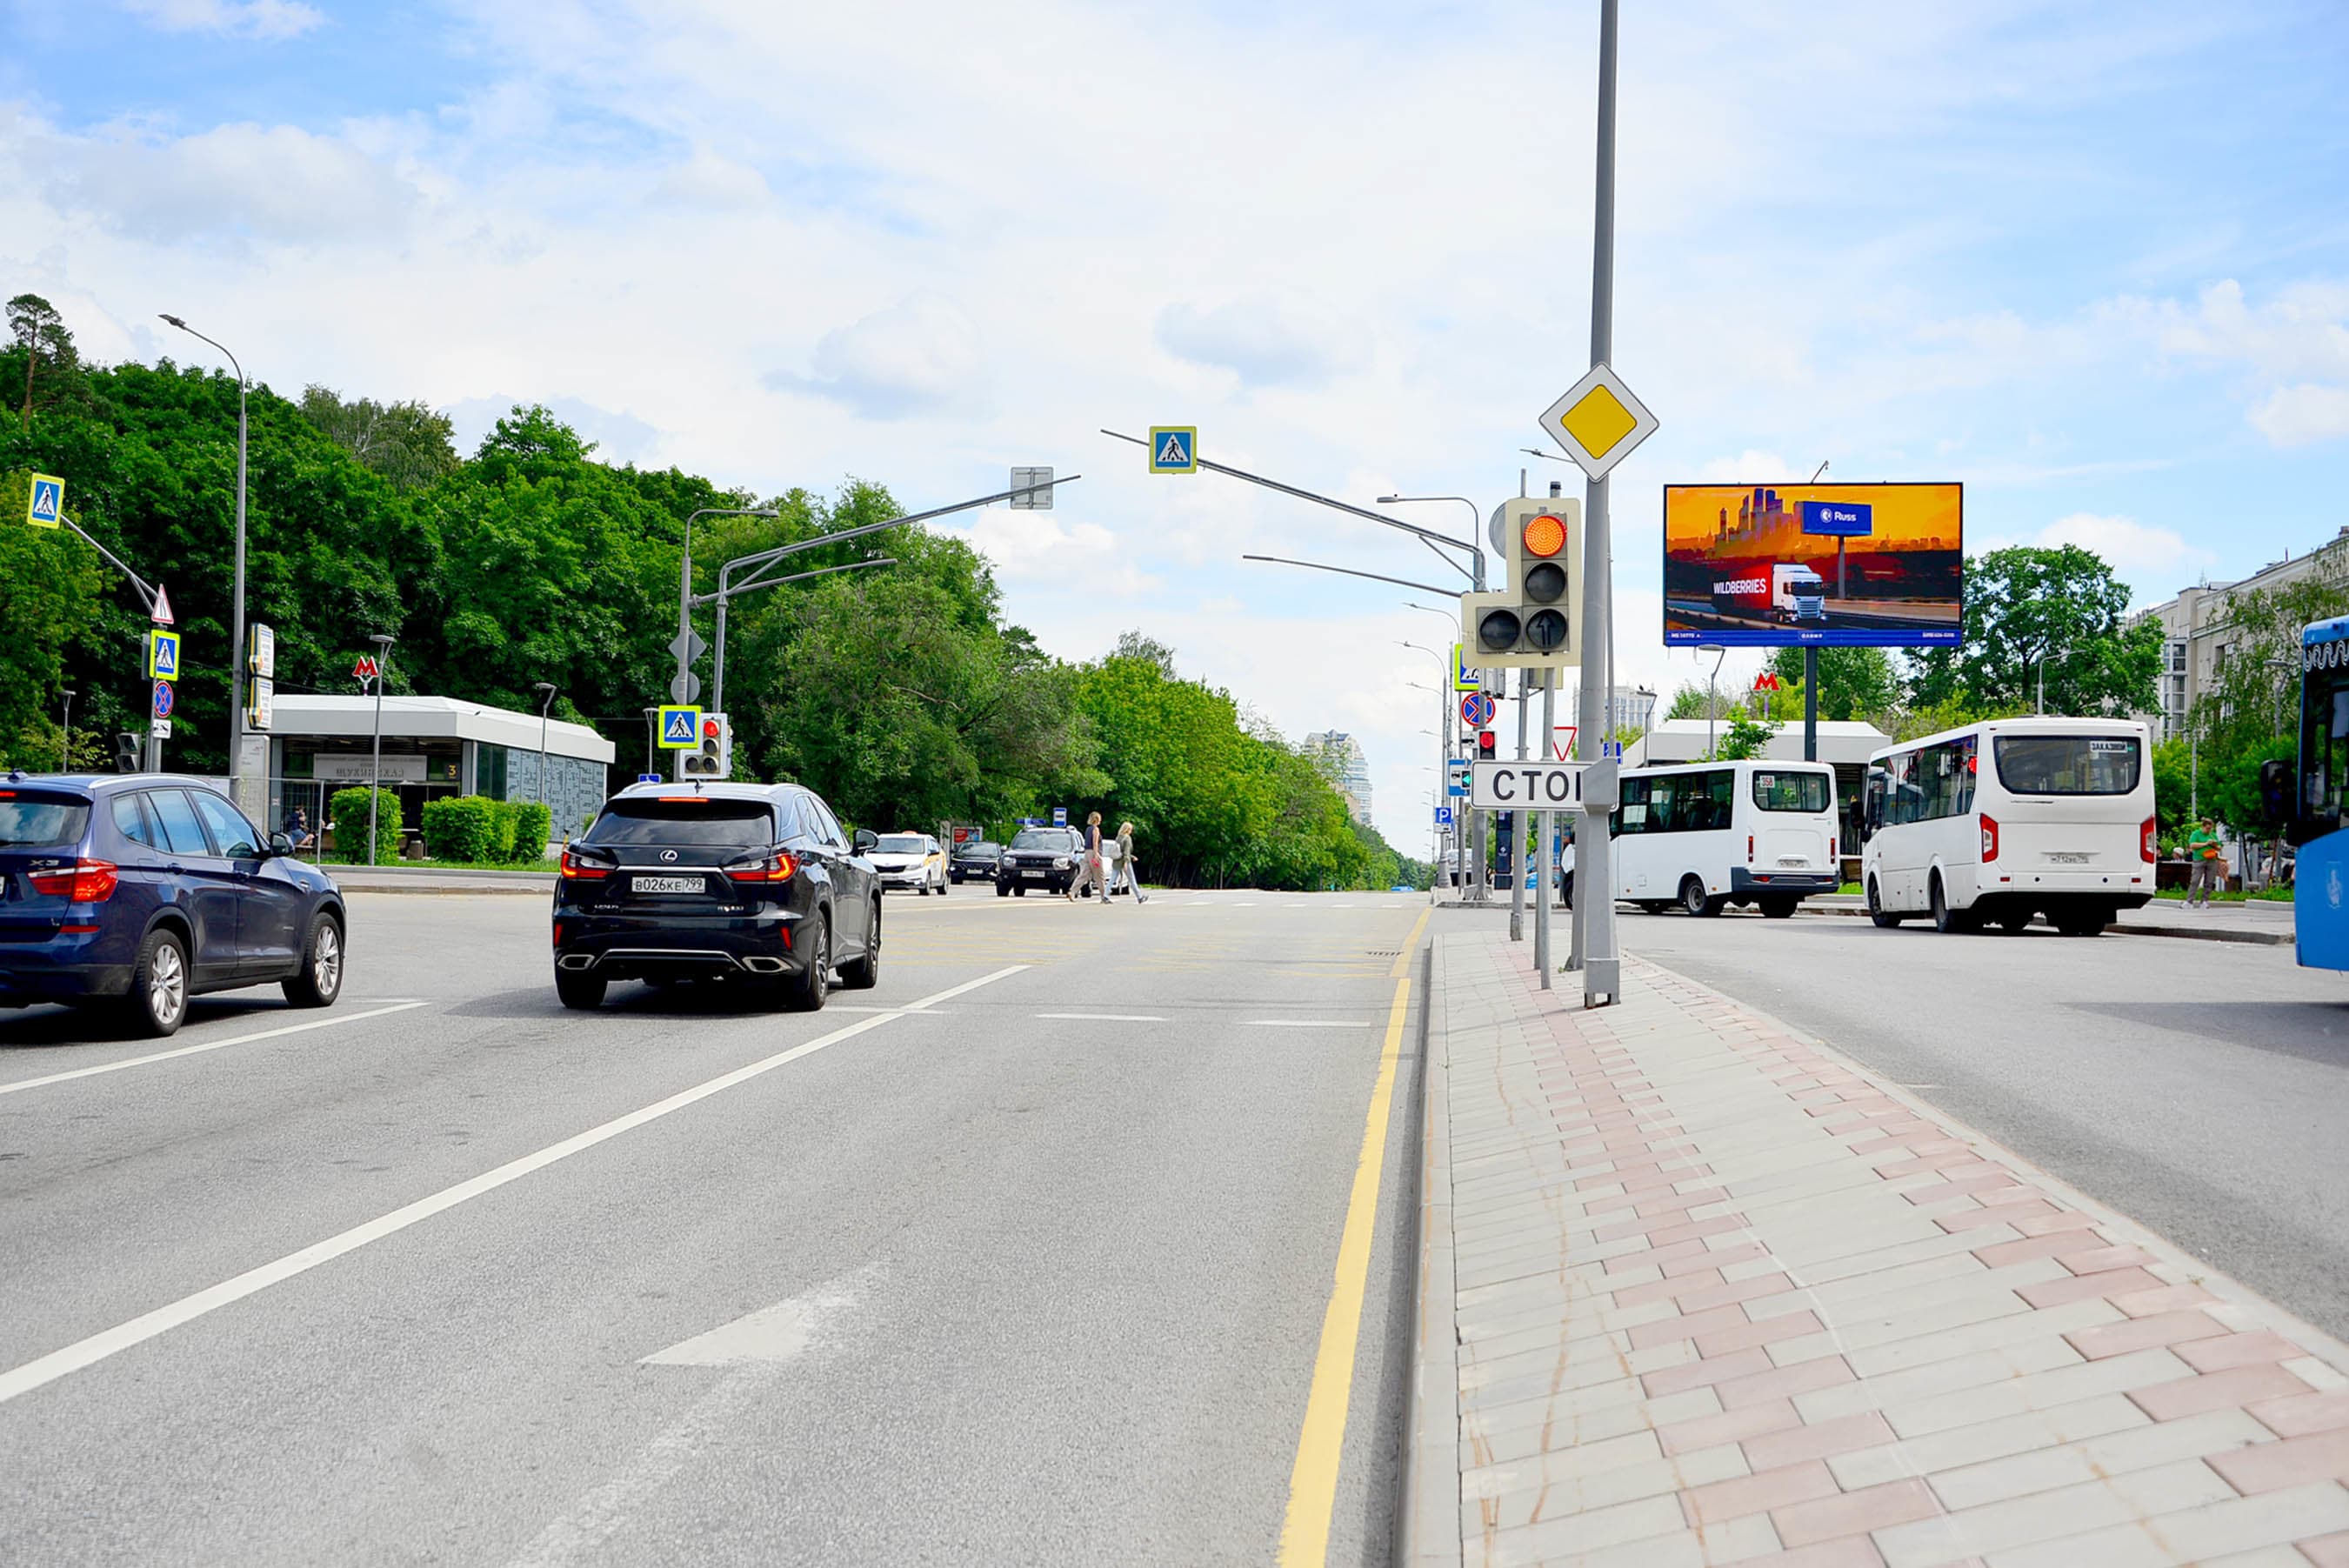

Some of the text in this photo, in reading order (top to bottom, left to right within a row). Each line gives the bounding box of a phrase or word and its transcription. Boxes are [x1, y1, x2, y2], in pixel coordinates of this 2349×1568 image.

[1834, 511, 1857, 522] Russ
[1713, 577, 1767, 594] WILDBERRIES
[448, 764, 457, 777] 3
[1438, 809, 1450, 821] P
